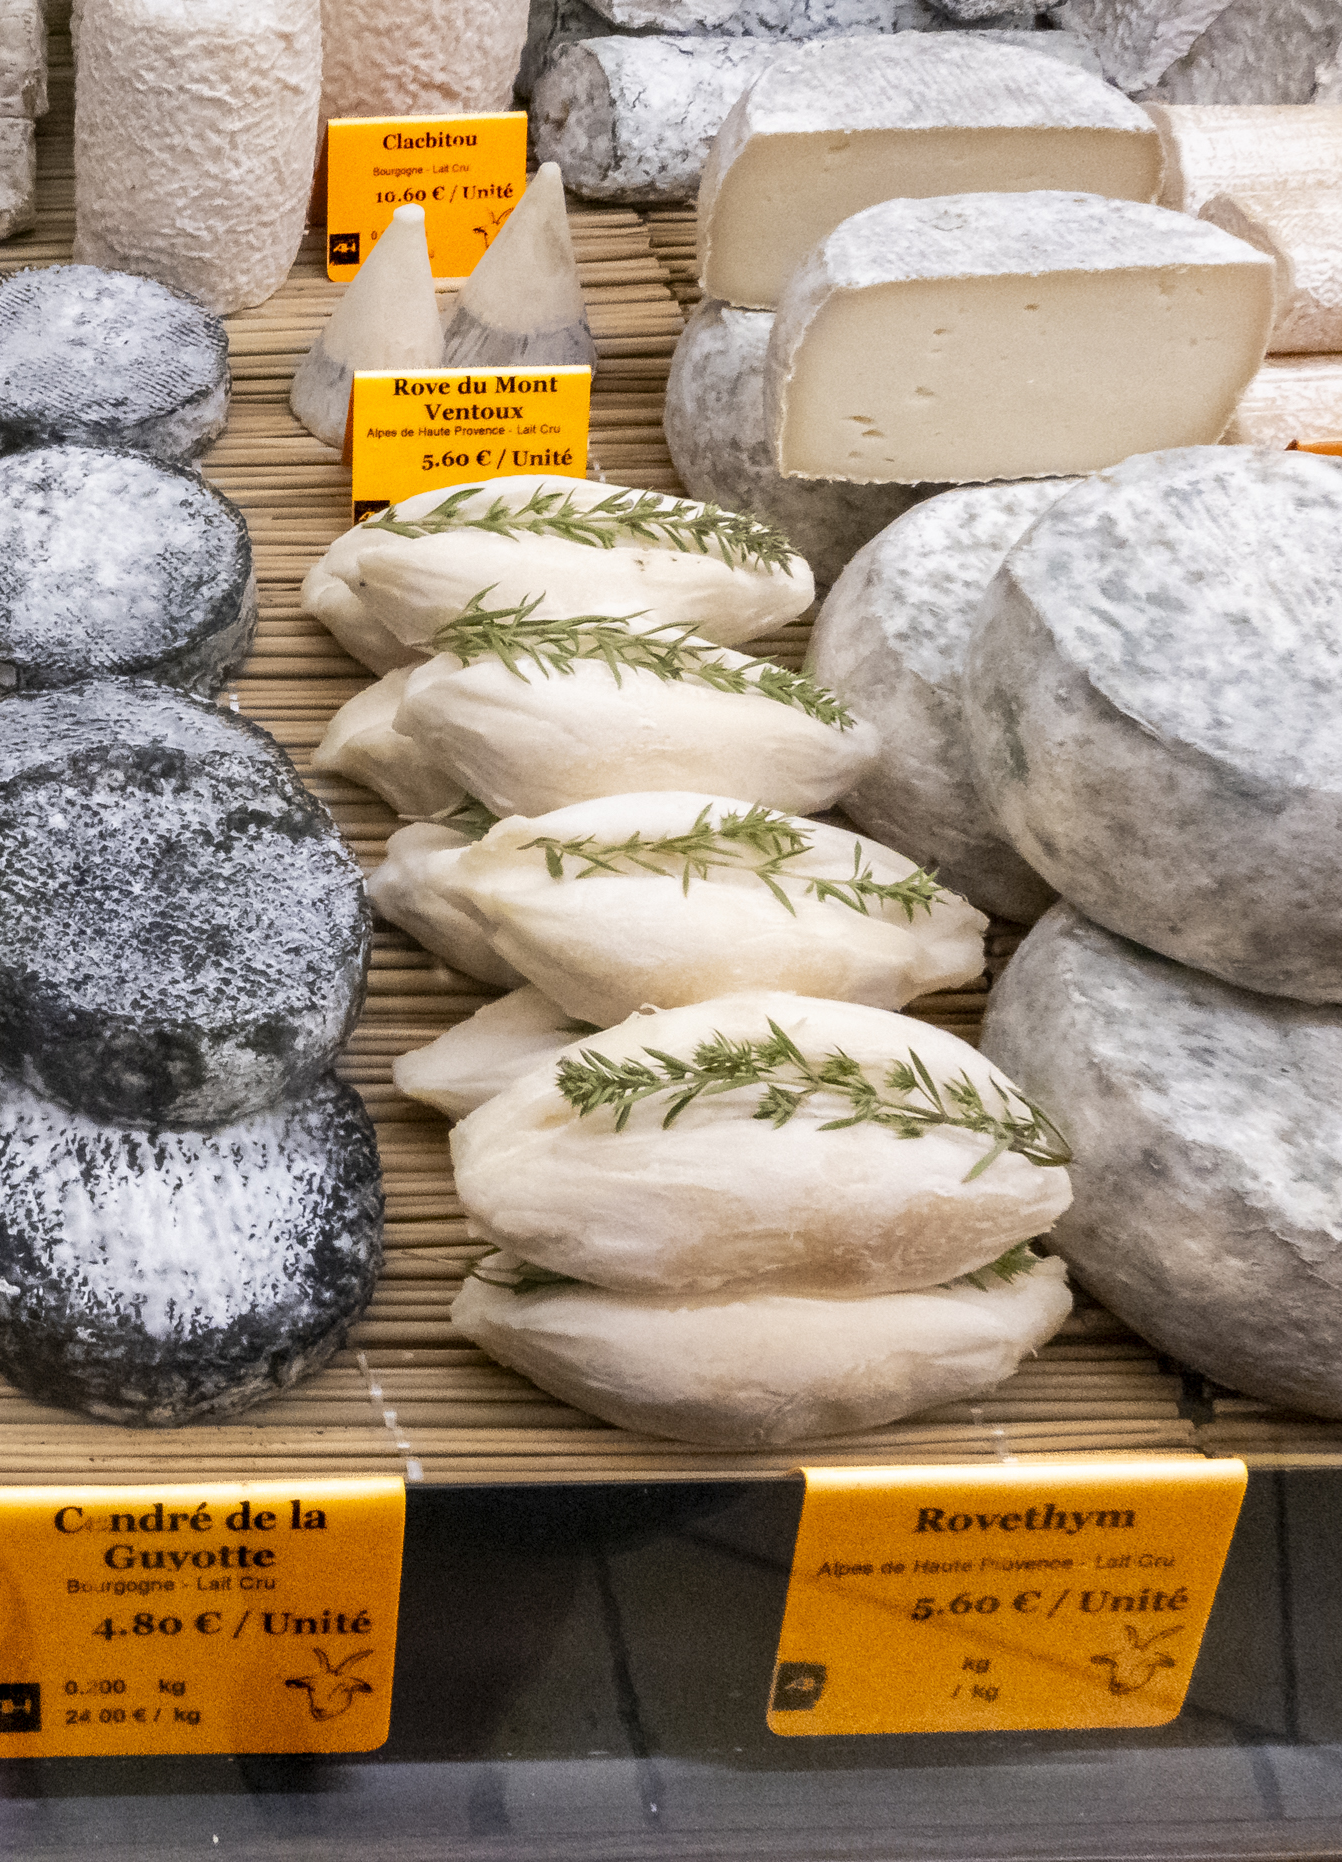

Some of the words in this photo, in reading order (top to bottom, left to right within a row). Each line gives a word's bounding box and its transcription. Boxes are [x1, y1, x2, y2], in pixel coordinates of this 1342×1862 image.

[383, 131, 478, 150] Clacbitou
[373, 166, 423, 177] Bourgogne
[433, 165, 449, 173] Lait
[452, 164, 469, 172] Cru
[376, 187, 426, 204] 10.60
[432, 186, 444, 200] €
[449, 185, 458, 203] /
[463, 183, 514, 200] Unité
[393, 378, 450, 396] Rove
[458, 376, 487, 394] du
[495, 376, 559, 395] Mont
[424, 403, 524, 421] Ventoux
[367, 427, 397, 438] Alpes
[401, 427, 414, 437] de
[419, 426, 450, 437] Haute
[455, 425, 505, 436] Provence
[517, 424, 536, 435] Lait
[540, 424, 561, 434] Cru
[421, 451, 469, 471] 5.60
[476, 449, 491, 466] €
[496, 448, 506, 470] /
[512, 448, 573, 467] Unité
[54, 1502, 213, 1534] Cndré
[225, 1500, 277, 1531] de
[290, 1499, 328, 1530] la
[912, 1503, 1136, 1535] Rovethym
[104, 1545, 276, 1572] Guyotte
[817, 1560, 874, 1578] Alpes
[880, 1560, 905, 1575] de
[913, 1559, 972, 1574] Haute
[1095, 1554, 1131, 1570] Lait
[1138, 1553, 1175, 1568] Cru
[197, 1576, 231, 1591] Lait
[240, 1576, 276, 1590] Cru
[911, 1593, 1000, 1621] 5.60
[1012, 1590, 1042, 1614] €
[1047, 1589, 1071, 1620] /
[1079, 1587, 1188, 1614] Unité
[92, 1612, 184, 1641] 4.80
[195, 1611, 222, 1634] €
[233, 1610, 252, 1638] /
[263, 1609, 373, 1635] Unité
[961, 1656, 992, 1674] kg
[158, 1679, 186, 1697] kg
[971, 1684, 1001, 1703] kg
[65, 1708, 126, 1724] 2400
[133, 1708, 146, 1723] €
[174, 1708, 201, 1725] kg
